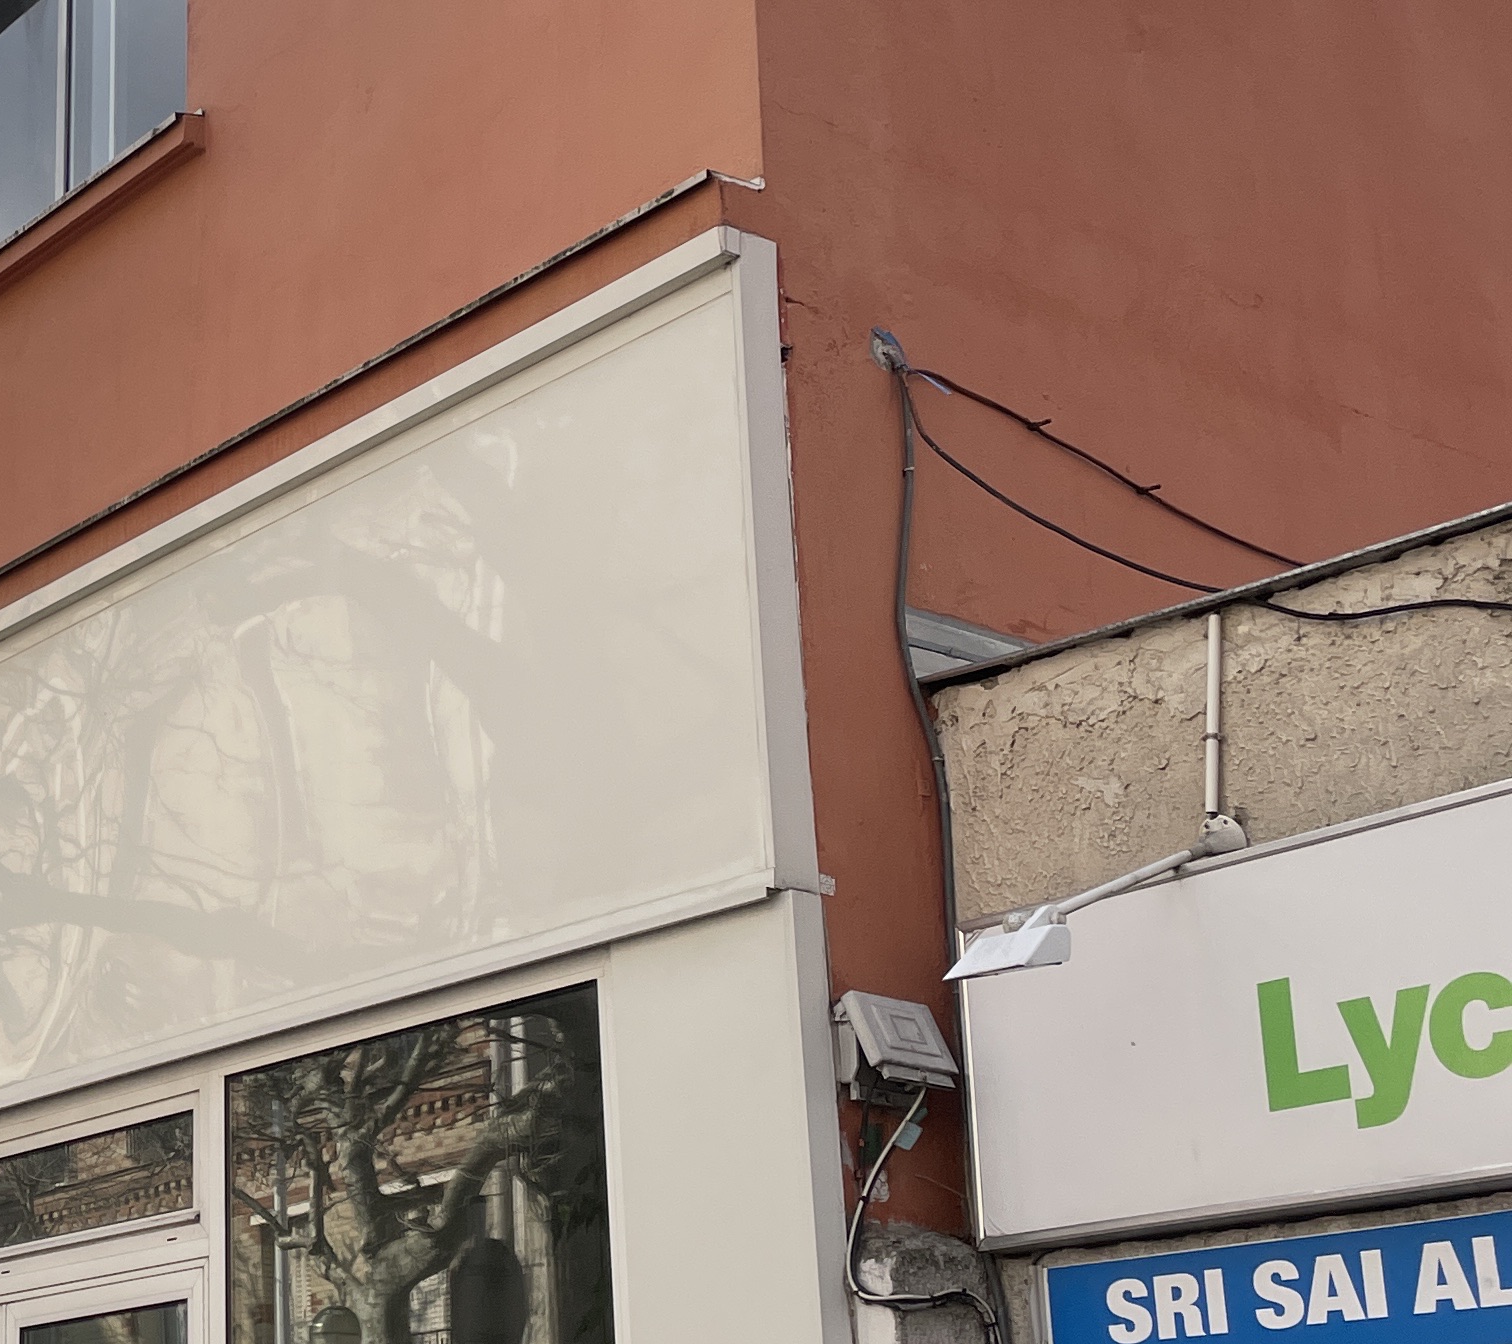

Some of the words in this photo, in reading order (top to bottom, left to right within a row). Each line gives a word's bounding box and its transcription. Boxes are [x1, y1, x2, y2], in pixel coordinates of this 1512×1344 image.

[1256, 971, 1512, 1130] Lyc
[1106, 1268, 1229, 1344] SRI
[1252, 1249, 1389, 1330] SAI
[1413, 1236, 1512, 1315] AL
